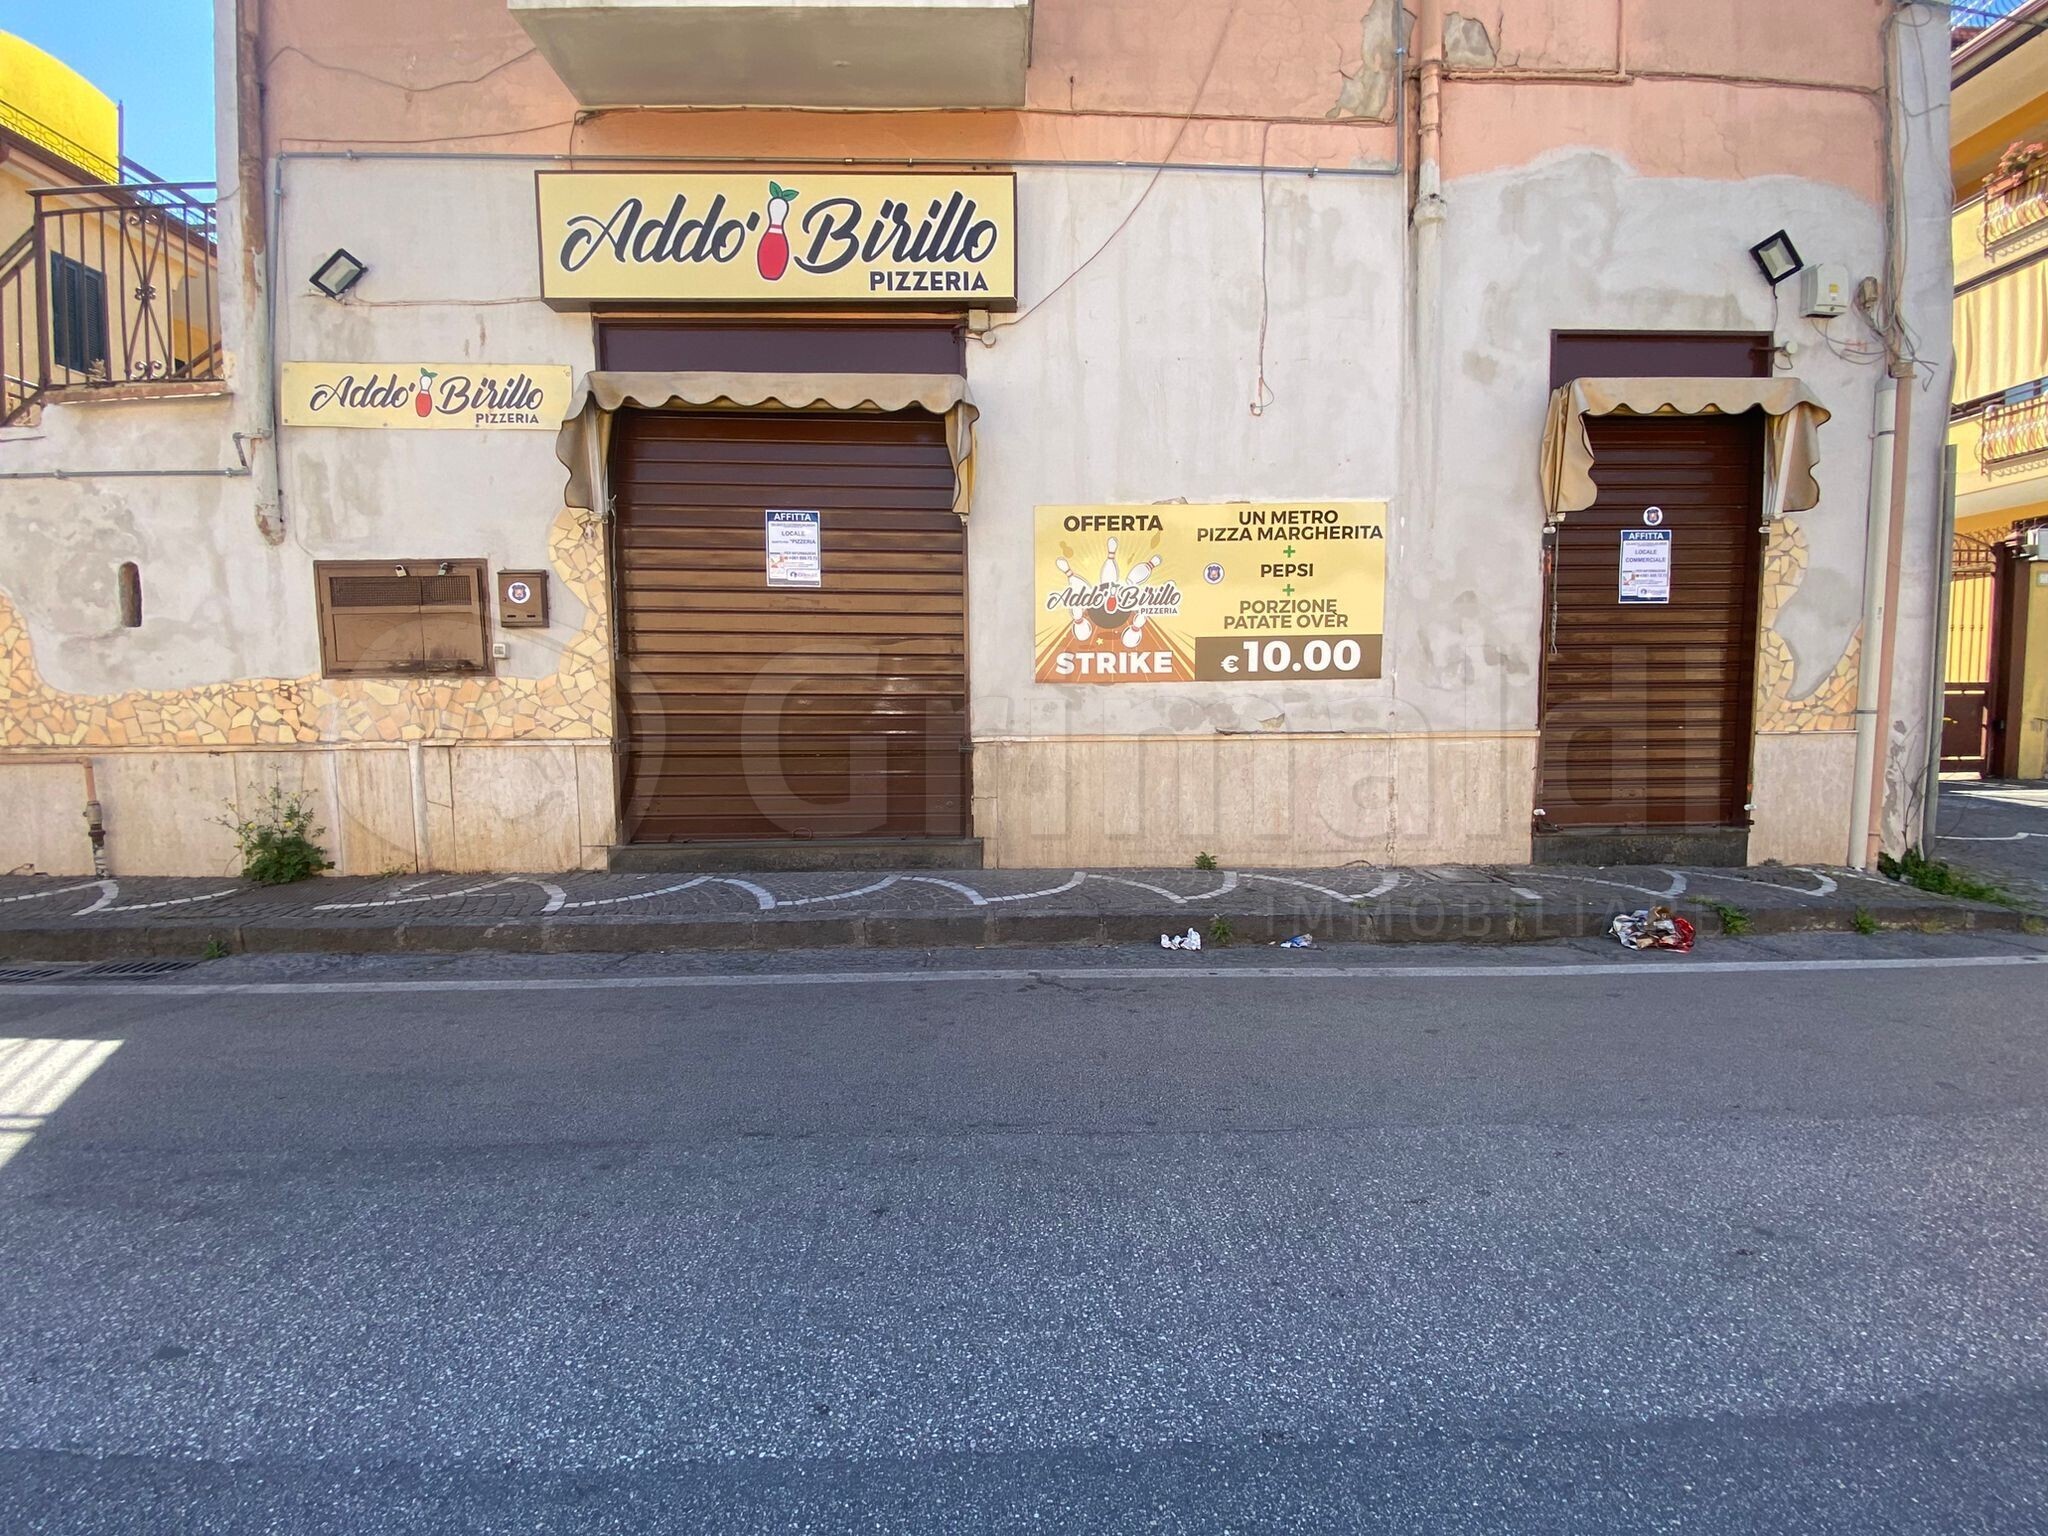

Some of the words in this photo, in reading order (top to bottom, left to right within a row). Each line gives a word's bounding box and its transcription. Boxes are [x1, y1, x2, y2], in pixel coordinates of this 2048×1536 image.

[794, 191, 998, 274] Birillo
[870, 271, 989, 291] PIZZERIA
[435, 373, 544, 414] Birillo
[475, 413, 540, 424] PIZZERIA
[774, 513, 811, 521] AFFITTA
[1063, 514, 1164, 532] OFFERTA
[1239, 511, 1268, 526] UN
[1271, 510, 1339, 525] METRO
[1197, 527, 1252, 542] PIZZA
[1257, 525, 1384, 541] MARGHERITA
[1260, 563, 1314, 578] PEPSI
[1118, 584, 1181, 609] Birillo
[1240, 599, 1338, 614] PORZIONE
[1224, 615, 1292, 629] PATATE
[1297, 614, 1348, 628] OVER
[1056, 651, 1173, 674] STRIKE
